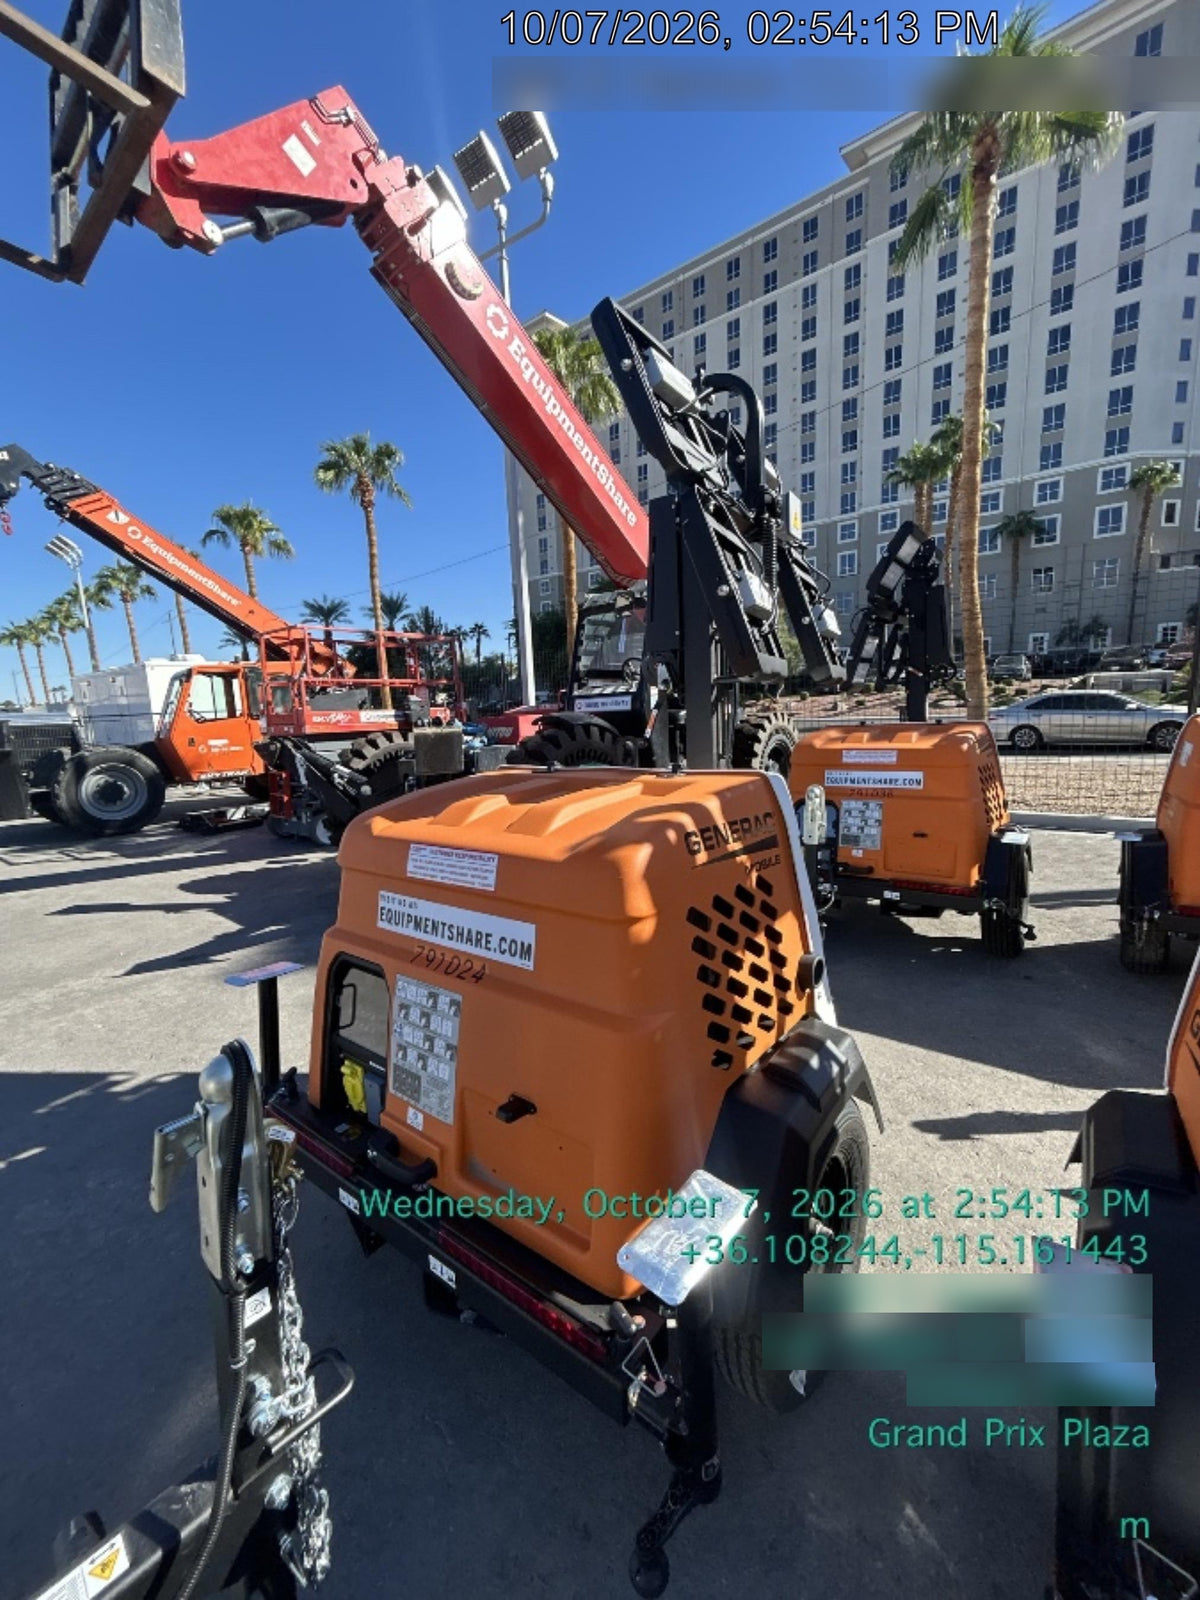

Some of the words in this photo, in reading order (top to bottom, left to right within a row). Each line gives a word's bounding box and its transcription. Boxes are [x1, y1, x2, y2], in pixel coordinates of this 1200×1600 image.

[507, 336, 637, 527] EquipmentShare
[379, 906, 533, 963] EQUIPMENTSHARE.COM
[410, 945, 487, 984] 791024
